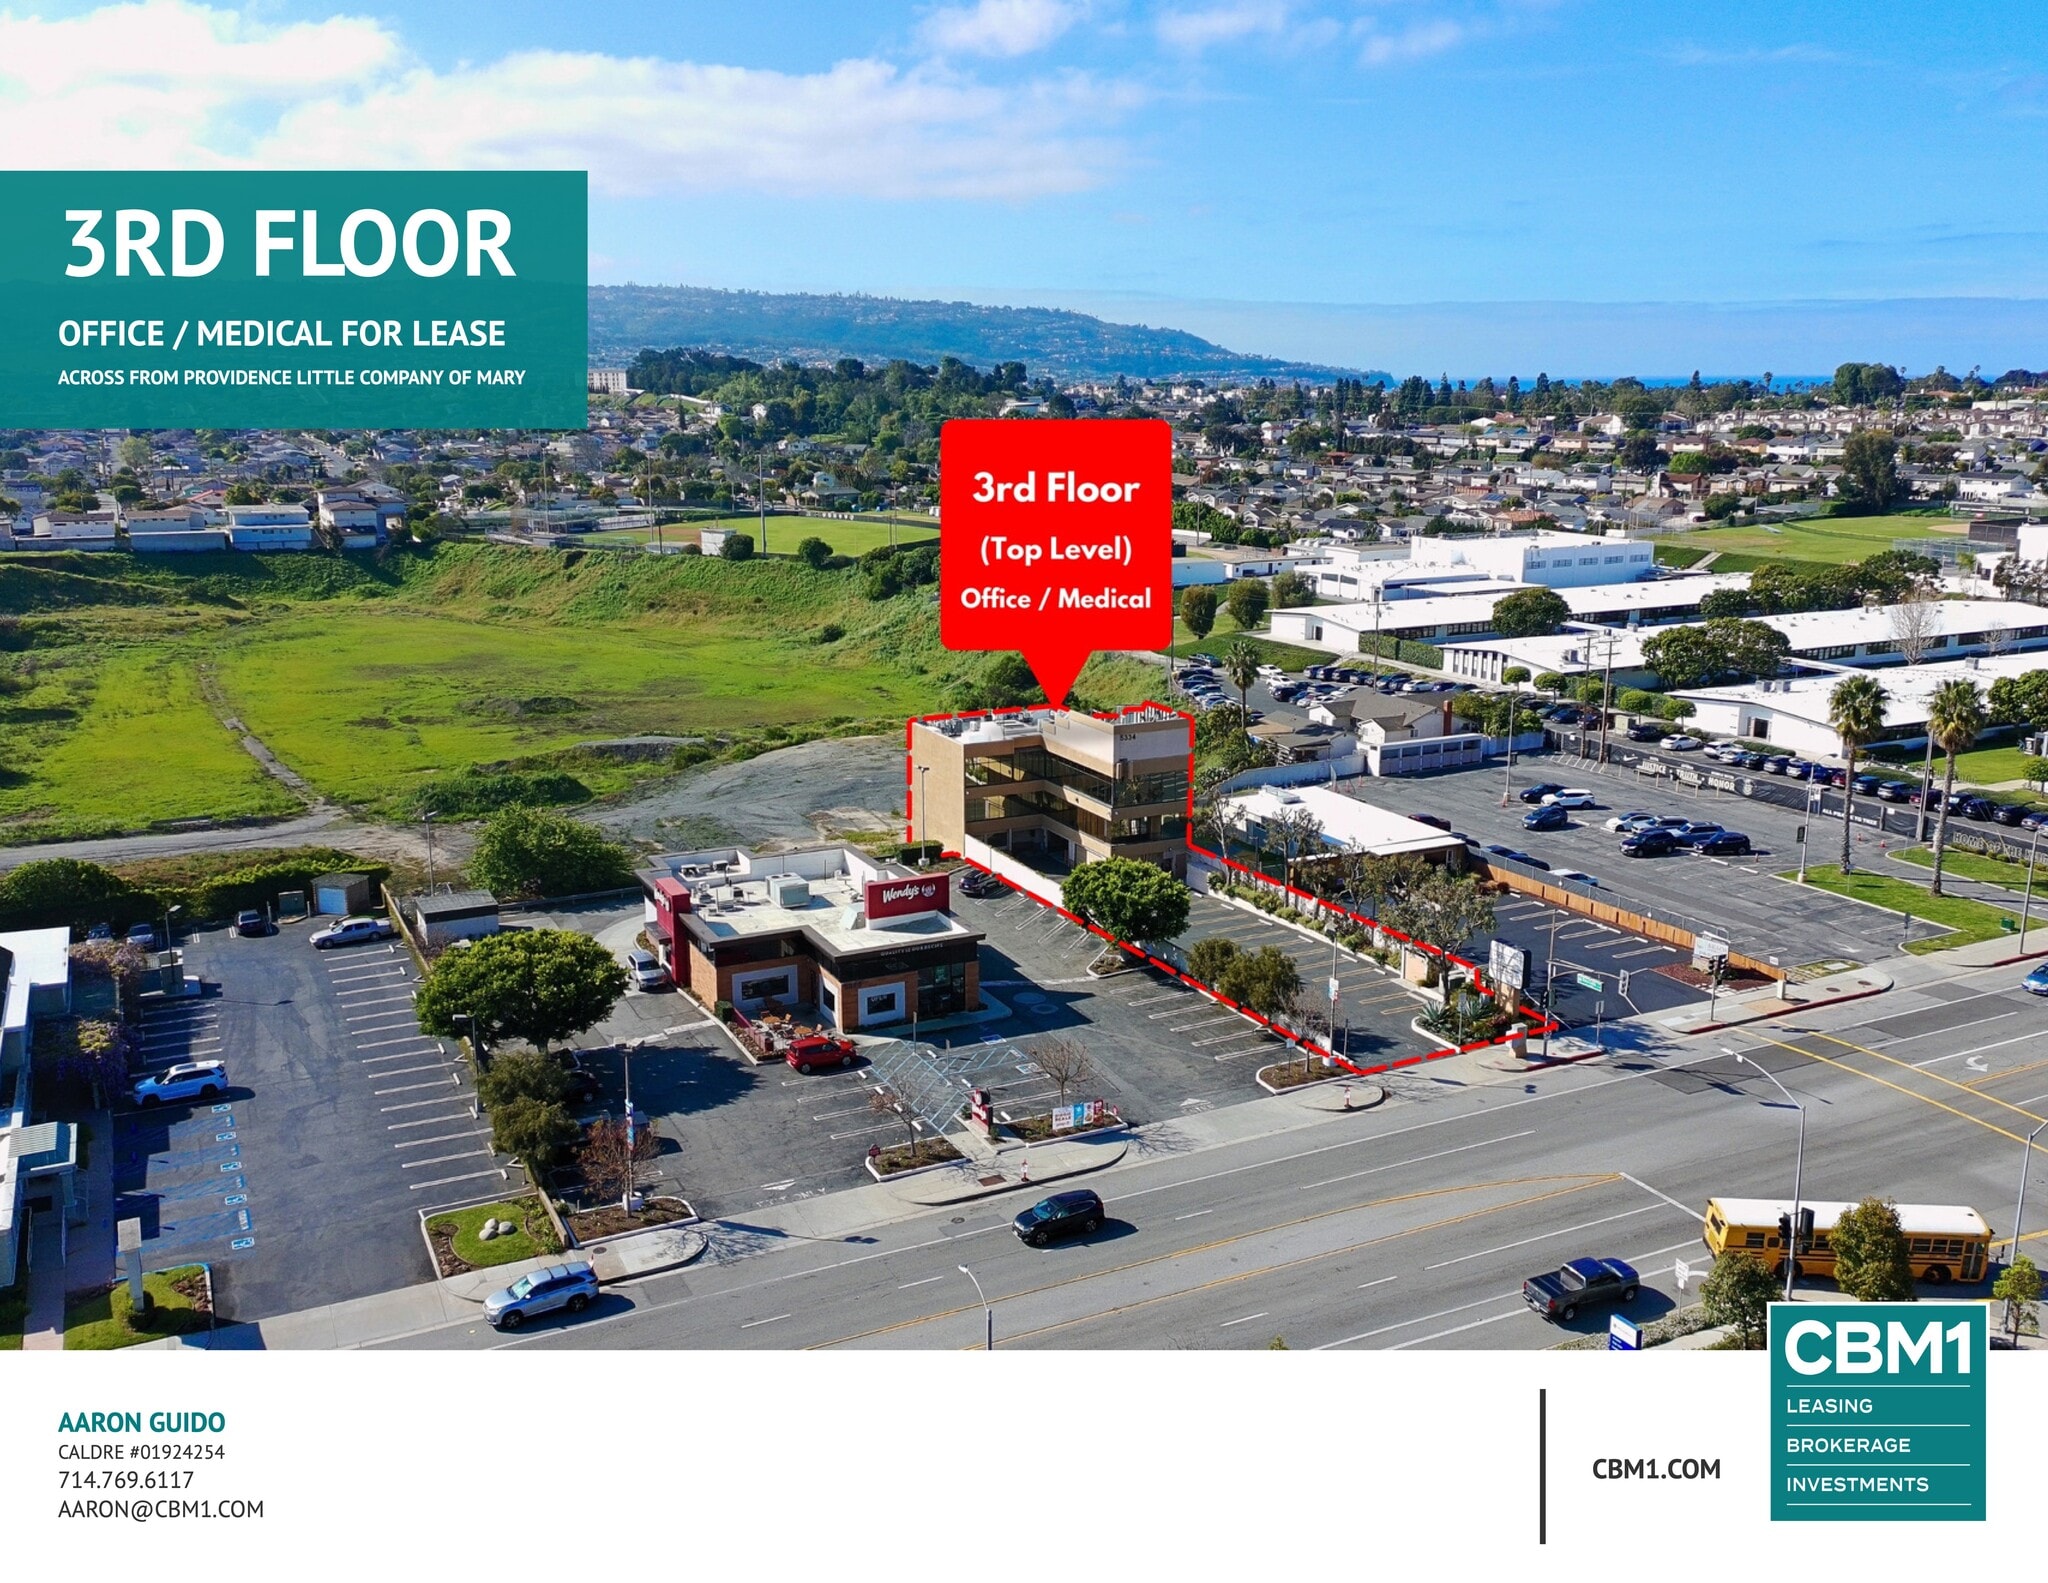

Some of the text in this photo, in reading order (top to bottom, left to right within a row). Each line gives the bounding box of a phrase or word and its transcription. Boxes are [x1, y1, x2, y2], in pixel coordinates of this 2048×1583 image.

[1642, 760, 1666, 774] JUSTICE
[1708, 777, 1735, 791] HONOR
[1952, 832, 1984, 850] HOME
[882, 884, 920, 904] Wendy's
